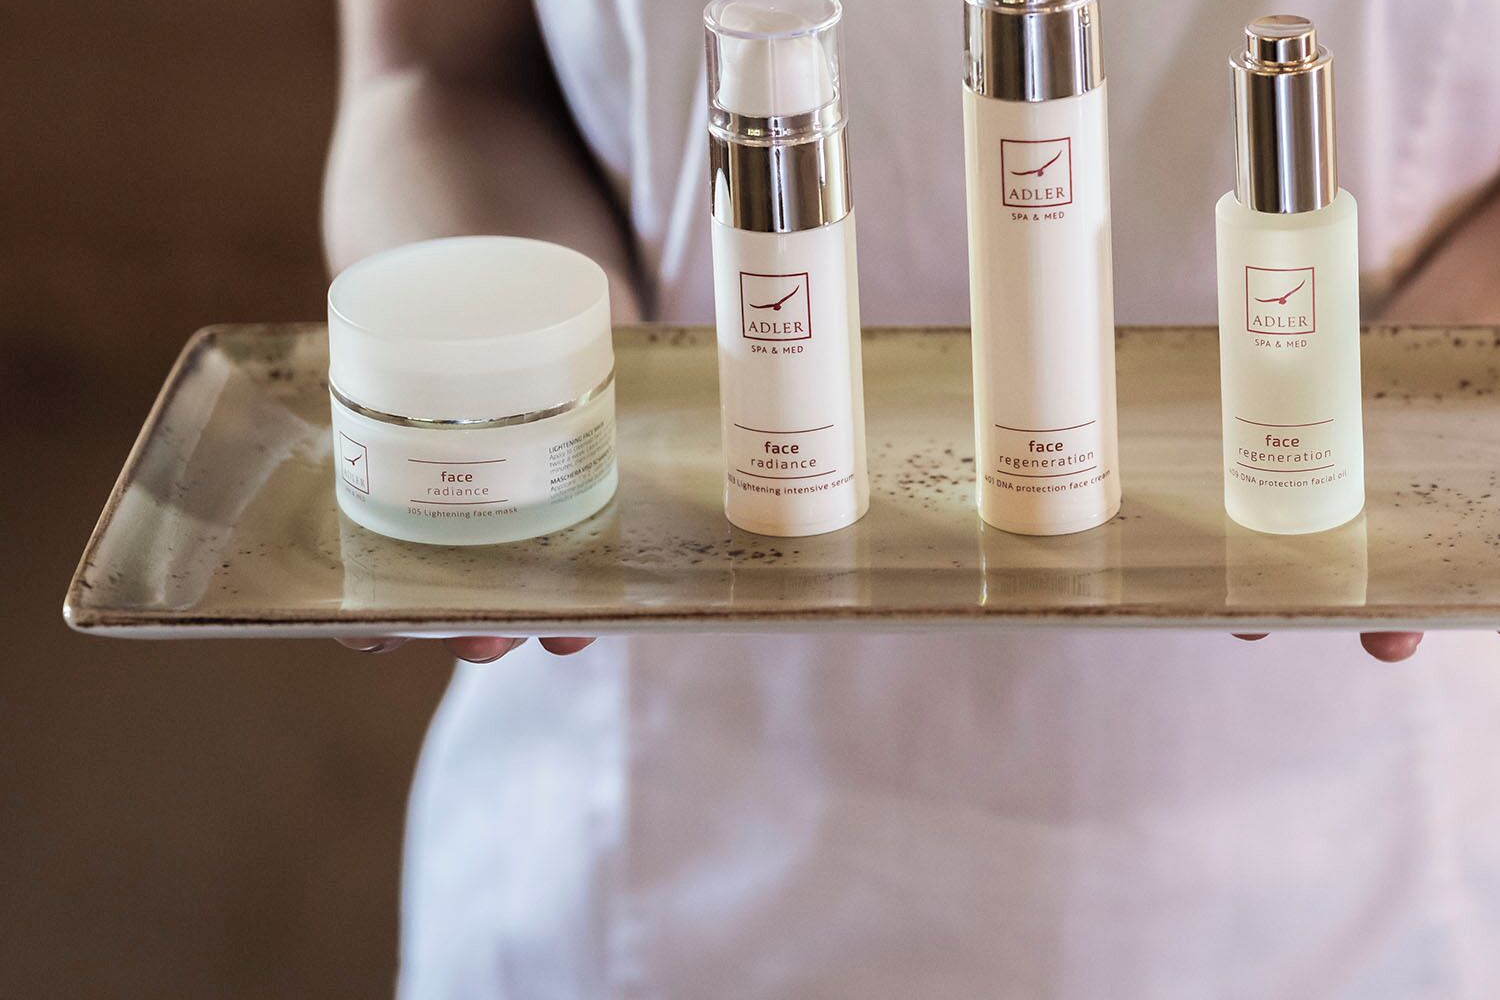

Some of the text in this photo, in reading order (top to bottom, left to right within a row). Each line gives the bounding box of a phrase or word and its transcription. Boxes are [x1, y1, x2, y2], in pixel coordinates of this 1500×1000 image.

[1009, 187, 1065, 200] ADLER
[1011, 213, 1028, 221] SPA
[1044, 211, 1065, 220] MED
[748, 321, 804, 334] ADLER
[1252, 315, 1308, 328] ADLER
[751, 345, 767, 353] SPA
[782, 345, 804, 354] MED
[1254, 338, 1271, 348] SPA
[1286, 339, 1308, 348] MED
[764, 441, 800, 454] face
[1029, 440, 1064, 453] face
[1265, 434, 1300, 448] face
[999, 451, 1094, 469] regeneration
[1239, 447, 1332, 463] regeneration
[750, 457, 817, 470] radiance
[441, 471, 473, 483] face
[1240, 473, 1257, 484] DNA
[1258, 476, 1308, 488] protection
[1311, 474, 1336, 485] facial
[427, 486, 489, 496] radiance
[736, 479, 781, 496] Lightening
[784, 483, 829, 495] intensive
[996, 479, 1014, 490] DNA
[1016, 482, 1067, 493] protection
[1069, 479, 1089, 489] face
[424, 509, 471, 519] Lightening
[495, 506, 518, 515] mask
